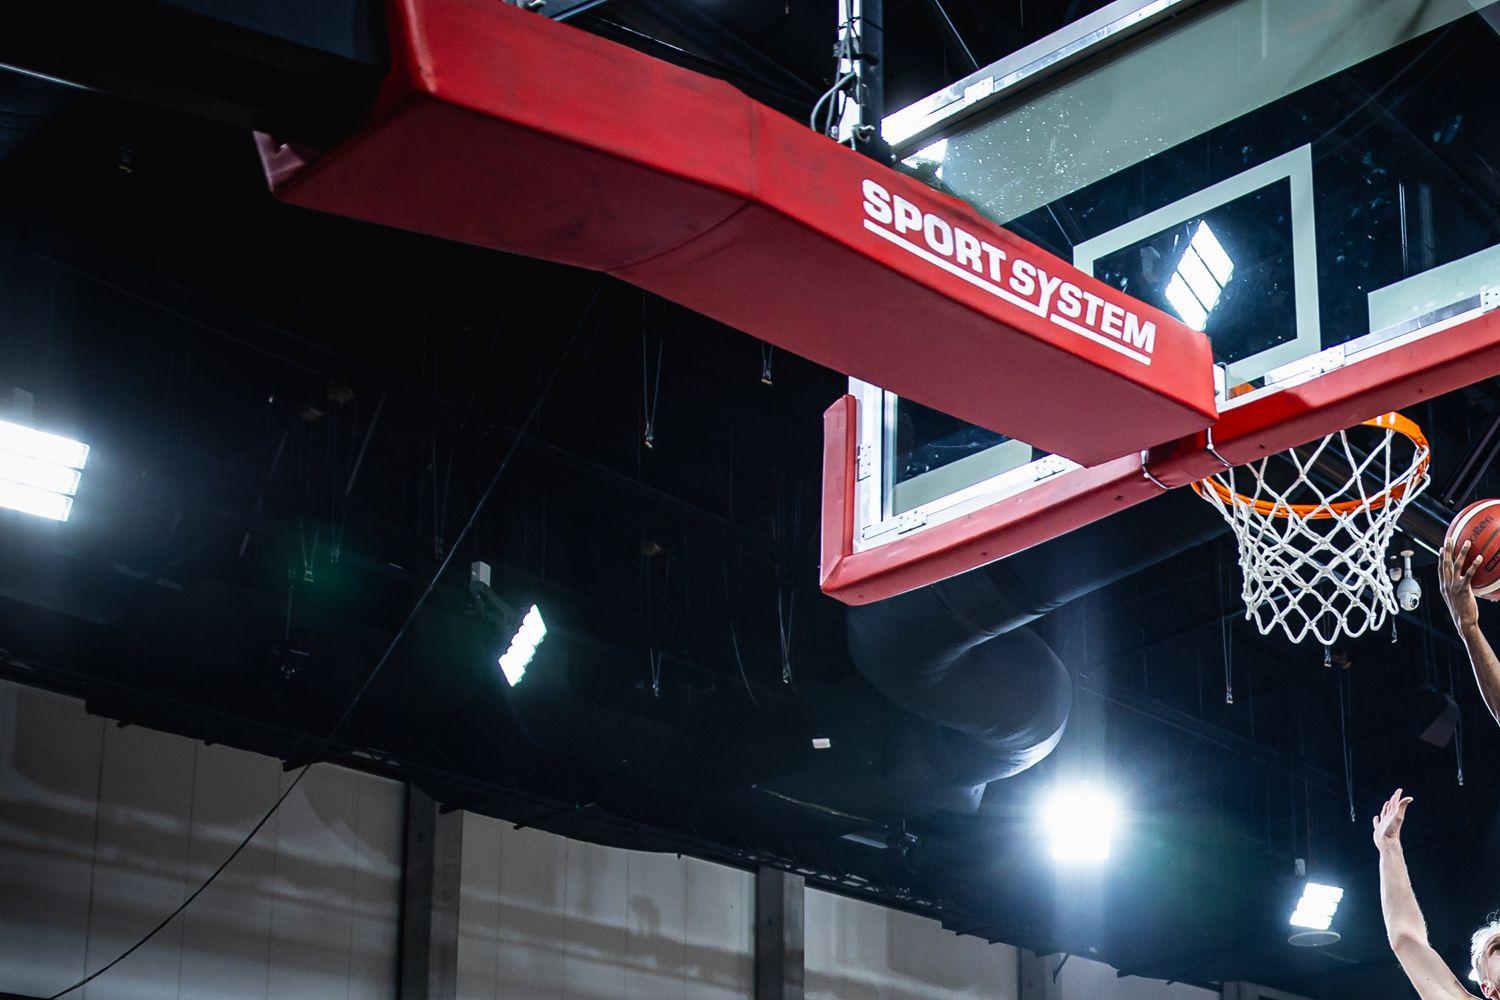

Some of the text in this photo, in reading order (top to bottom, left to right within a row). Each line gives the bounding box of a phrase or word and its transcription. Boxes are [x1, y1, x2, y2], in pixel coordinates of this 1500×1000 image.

[862, 178, 1157, 355] SPORT SYSTEM
[1469, 515, 1494, 542] olten
